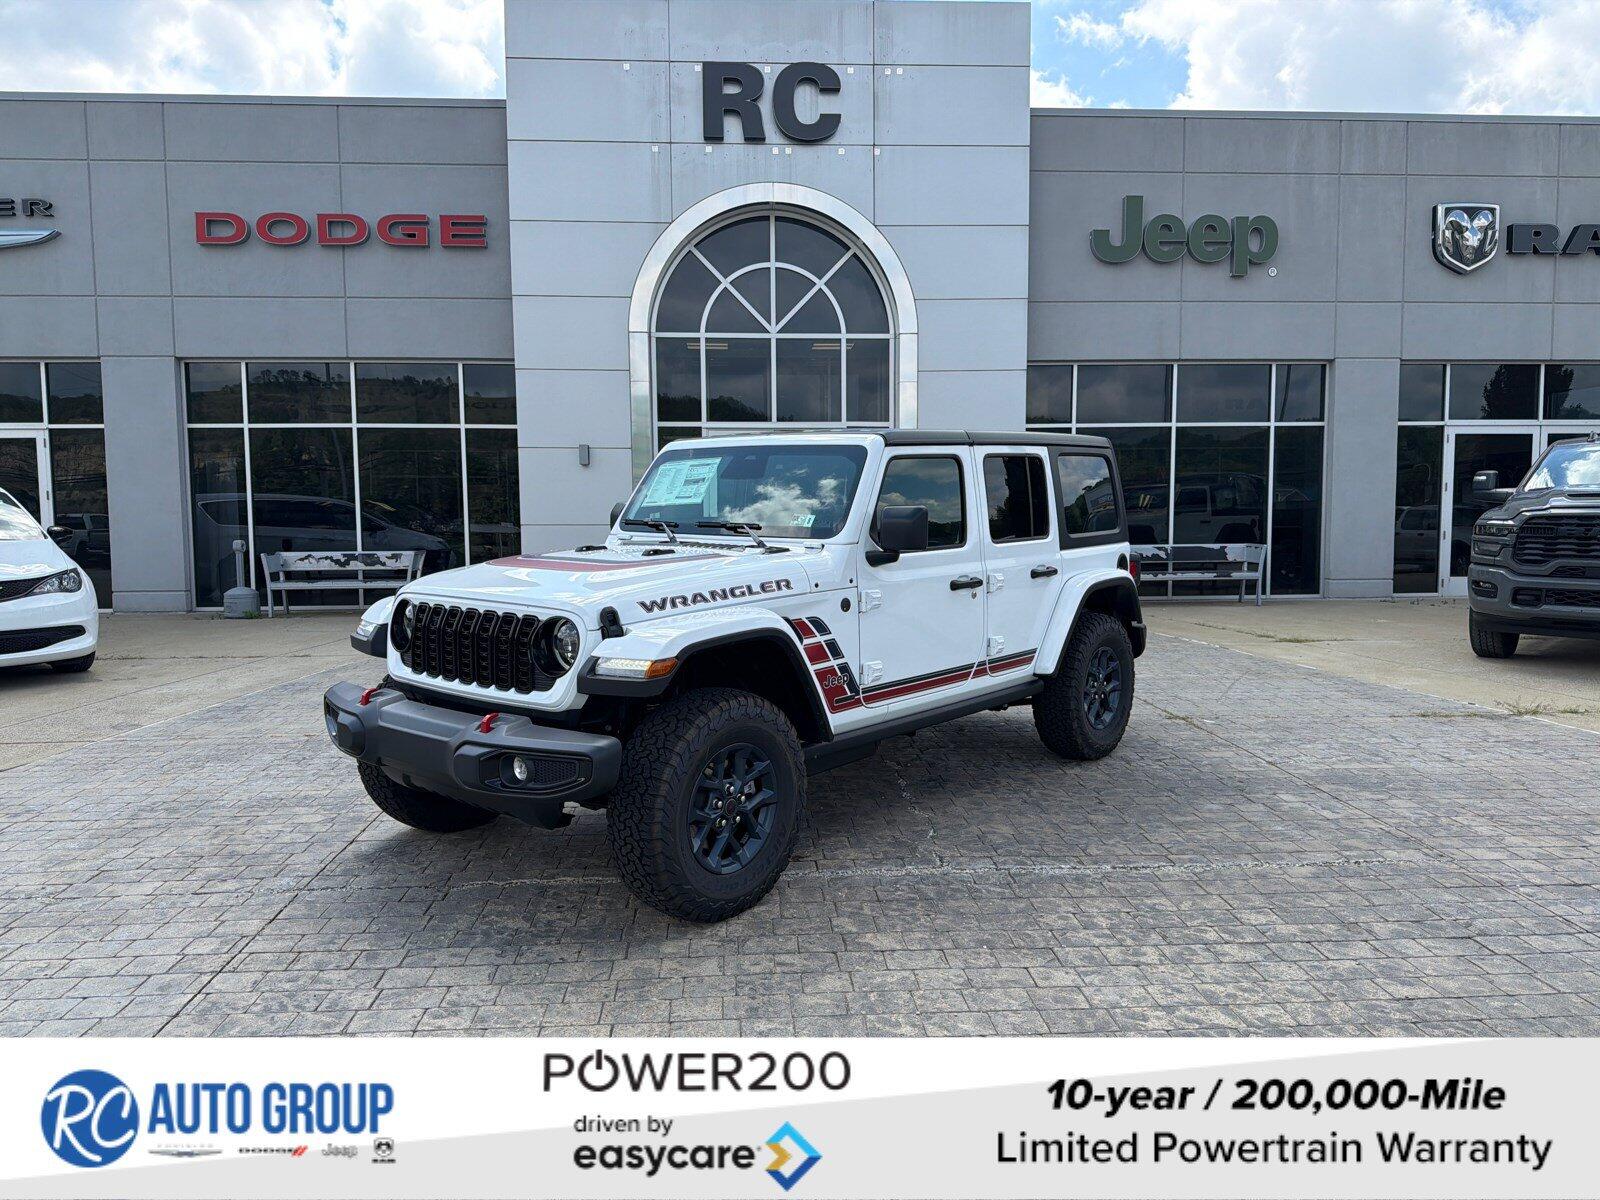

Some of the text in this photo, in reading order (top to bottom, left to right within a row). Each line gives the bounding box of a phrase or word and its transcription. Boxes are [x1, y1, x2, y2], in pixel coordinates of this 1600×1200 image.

[702, 61, 842, 142] RC
[195, 211, 487, 248] DODGE
[1090, 194, 1279, 278] Jeep
[636, 578, 794, 614] WRANGLER
[822, 672, 850, 689] Jeep
